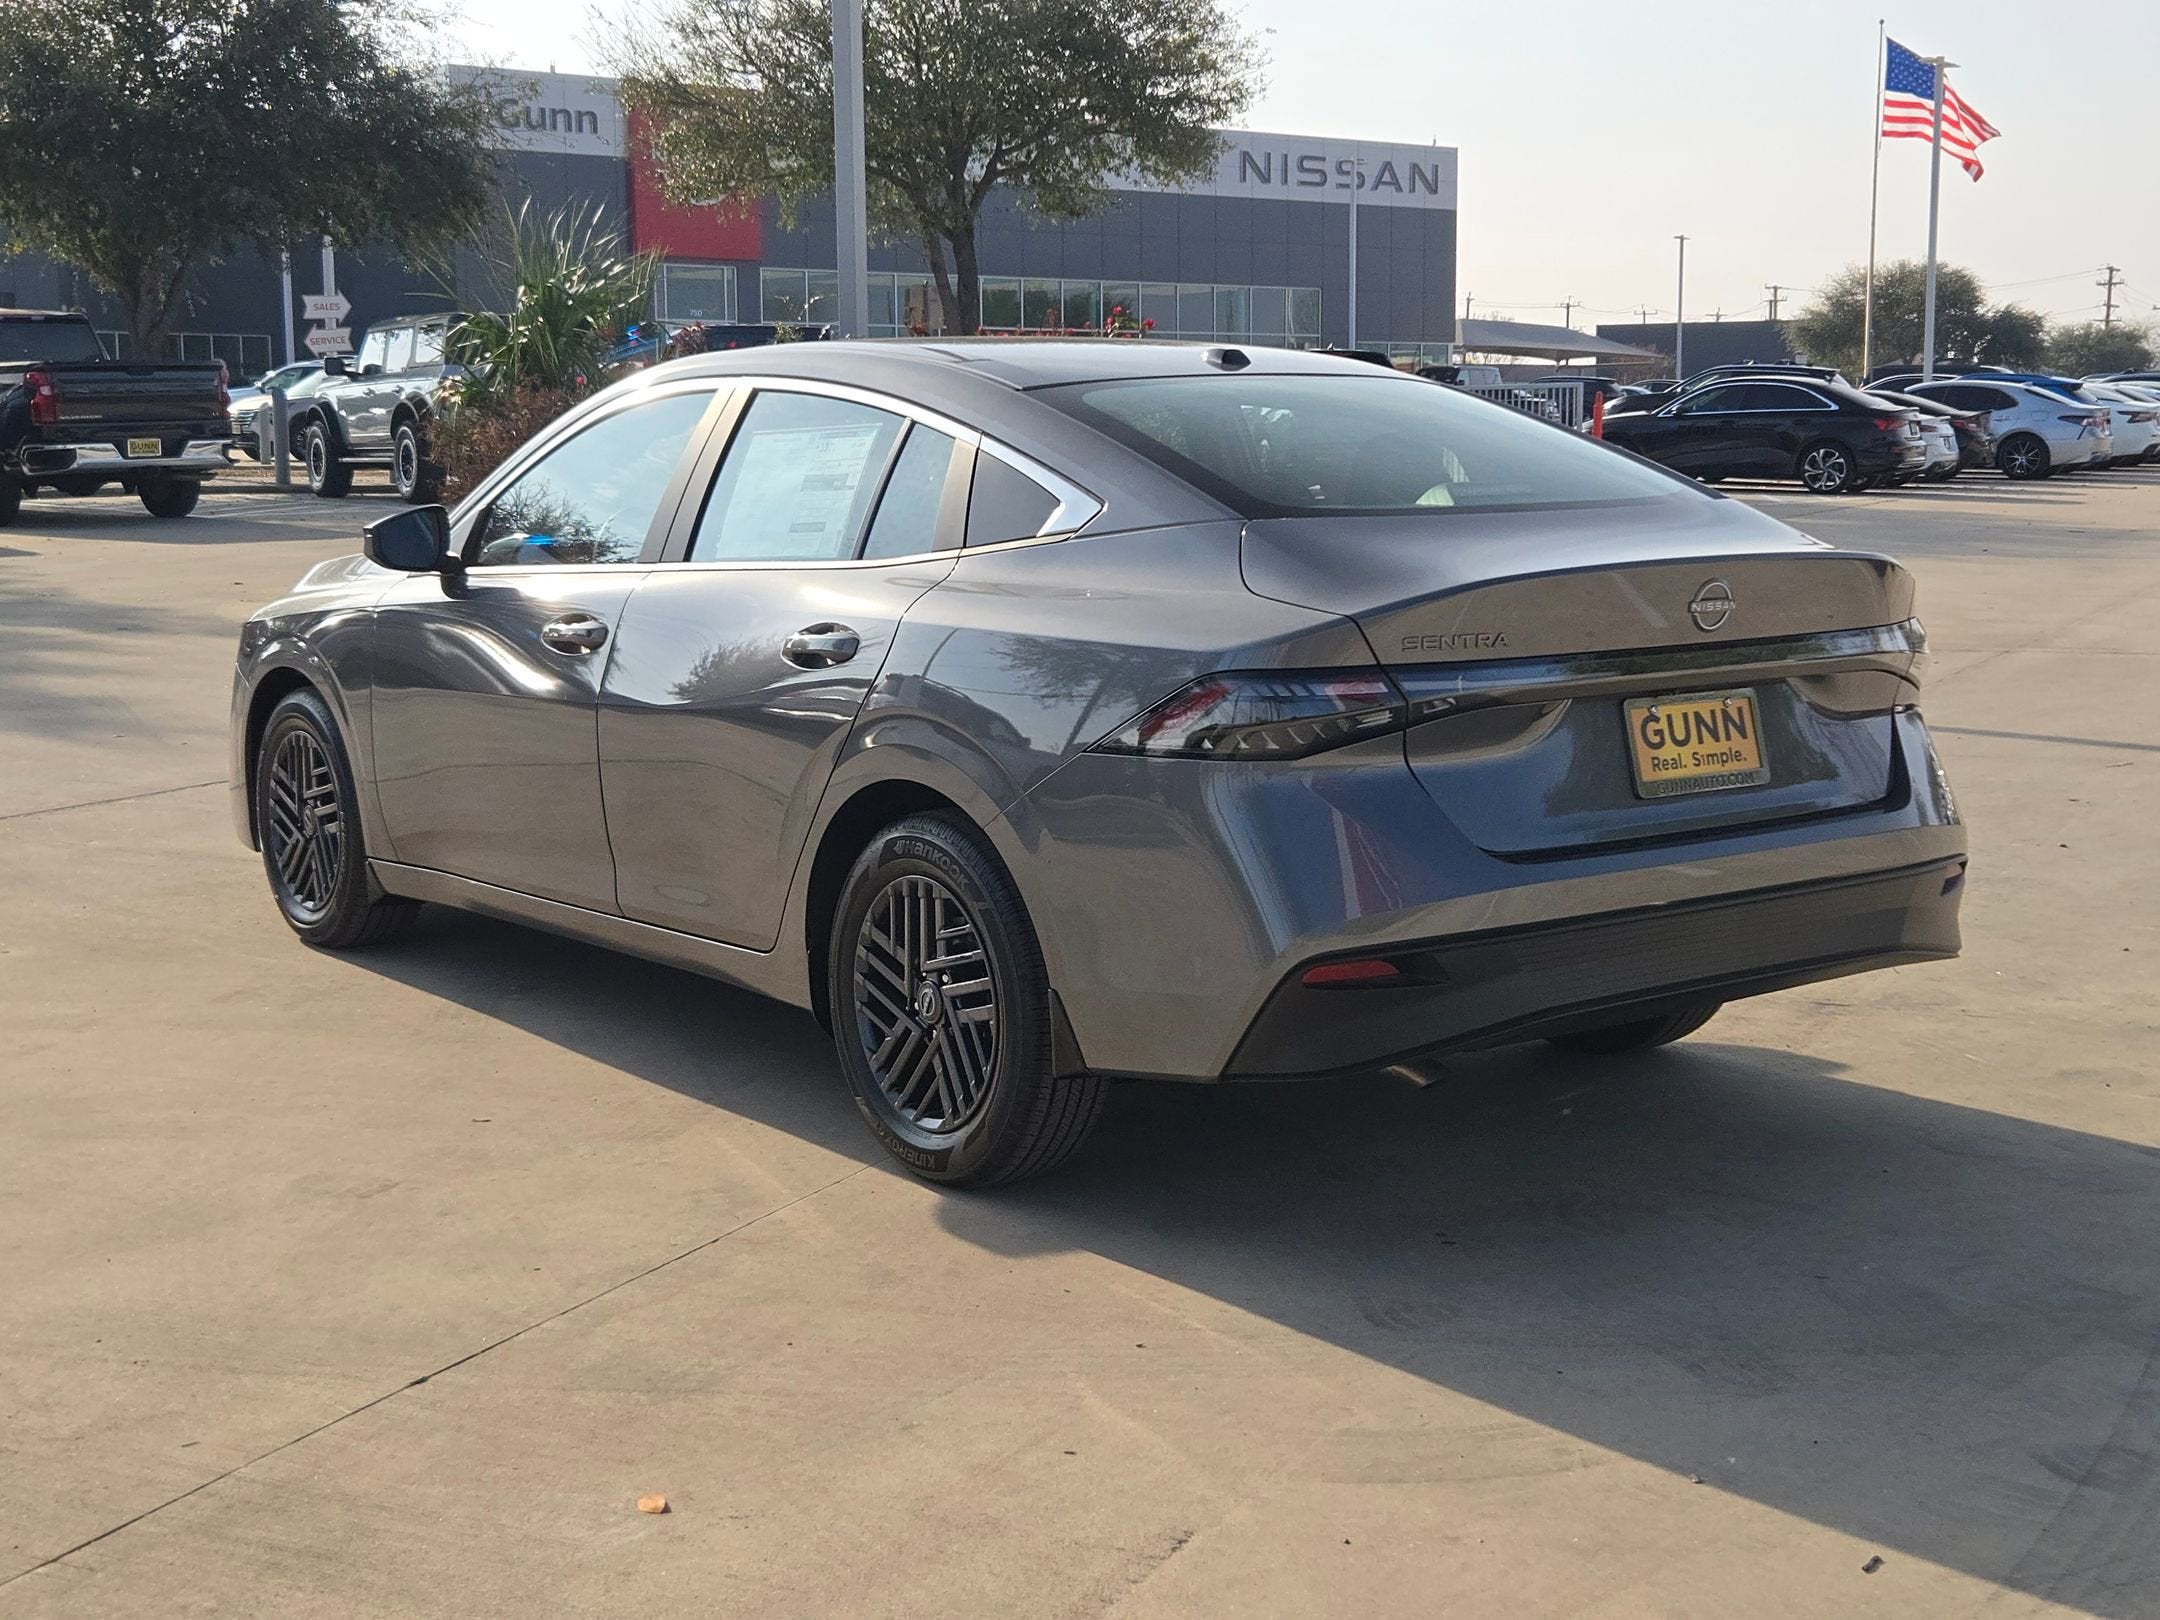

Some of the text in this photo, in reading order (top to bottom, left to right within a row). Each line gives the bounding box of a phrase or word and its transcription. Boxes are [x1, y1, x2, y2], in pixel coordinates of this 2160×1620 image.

[497, 98, 599, 135] Gunn
[1238, 149, 1440, 195] NISSAN
[313, 302, 341, 311] SALES
[310, 335, 347, 346] SERVICE
[130, 442, 158, 450] GUNN
[1691, 600, 1736, 612] NISSAN
[1401, 631, 1509, 652] SENTRA
[1640, 705, 1749, 751] GUNN
[1650, 746, 1748, 772] Real. Simple.
[1656, 771, 1757, 794] GUNNAUTO.COM
